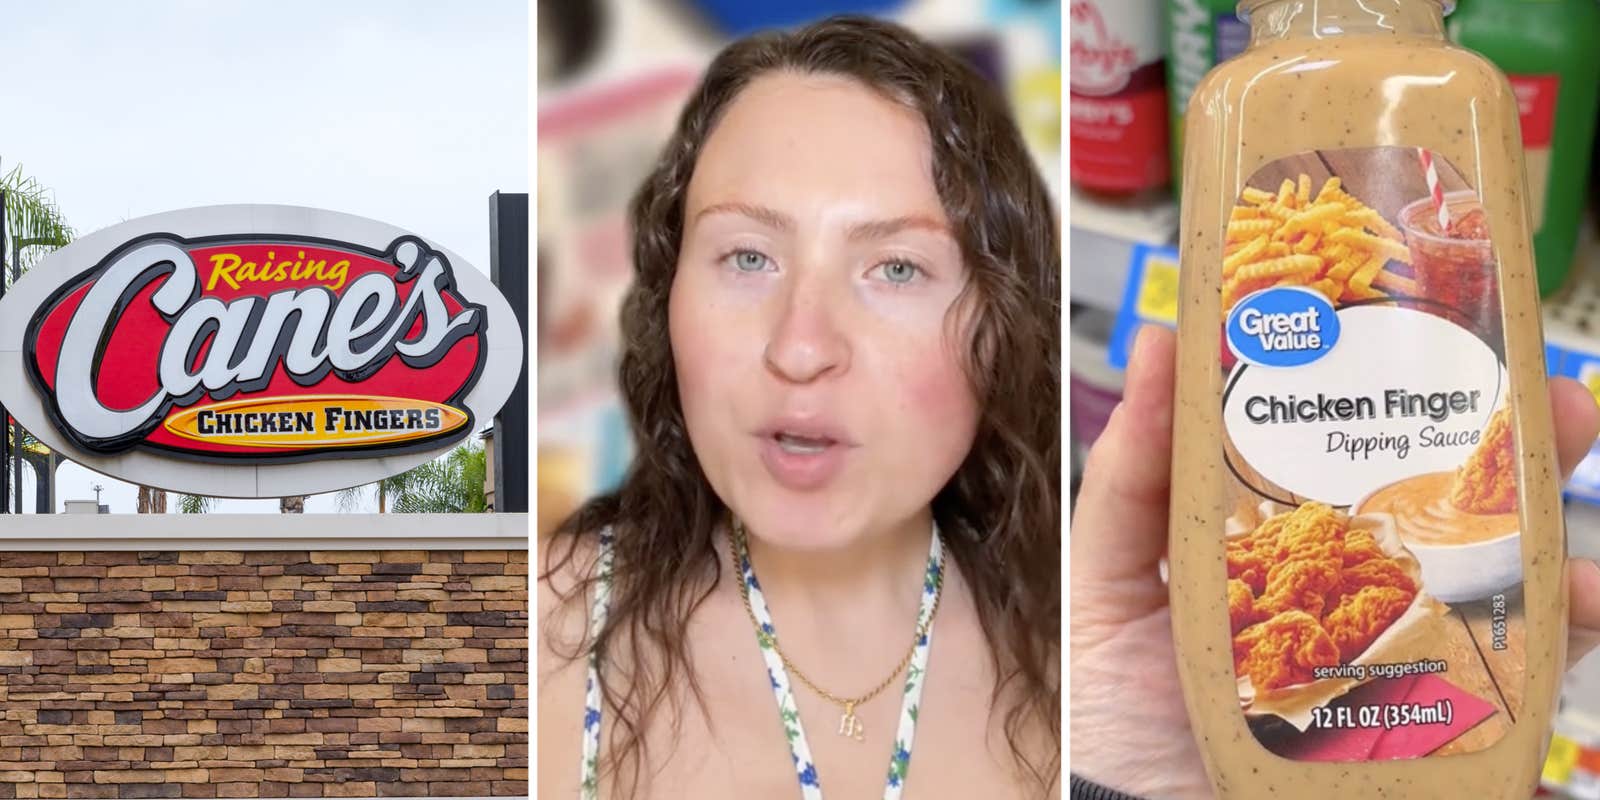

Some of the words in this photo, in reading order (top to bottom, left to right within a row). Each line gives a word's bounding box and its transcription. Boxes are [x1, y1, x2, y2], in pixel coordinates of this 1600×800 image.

[206, 251, 350, 290] Raising
[1239, 306, 1321, 335] Great
[55, 242, 476, 438] Cane's
[1259, 331, 1321, 351] Value
[197, 410, 314, 434] CHICKEN
[324, 407, 441, 432] FINGERS
[1245, 393, 1376, 424] Chicken
[1384, 389, 1481, 422] Finger
[1326, 431, 1410, 460] Dipping
[1418, 425, 1481, 448] Sauce
[1492, 593, 1507, 650] P1651283
[1313, 663, 1365, 679] serving
[1369, 659, 1447, 679] suggestion
[1313, 708, 1333, 728] 12
[1337, 707, 1356, 727] FL
[1359, 706, 1380, 727] OZ
[1384, 701, 1453, 728] (354mL)
